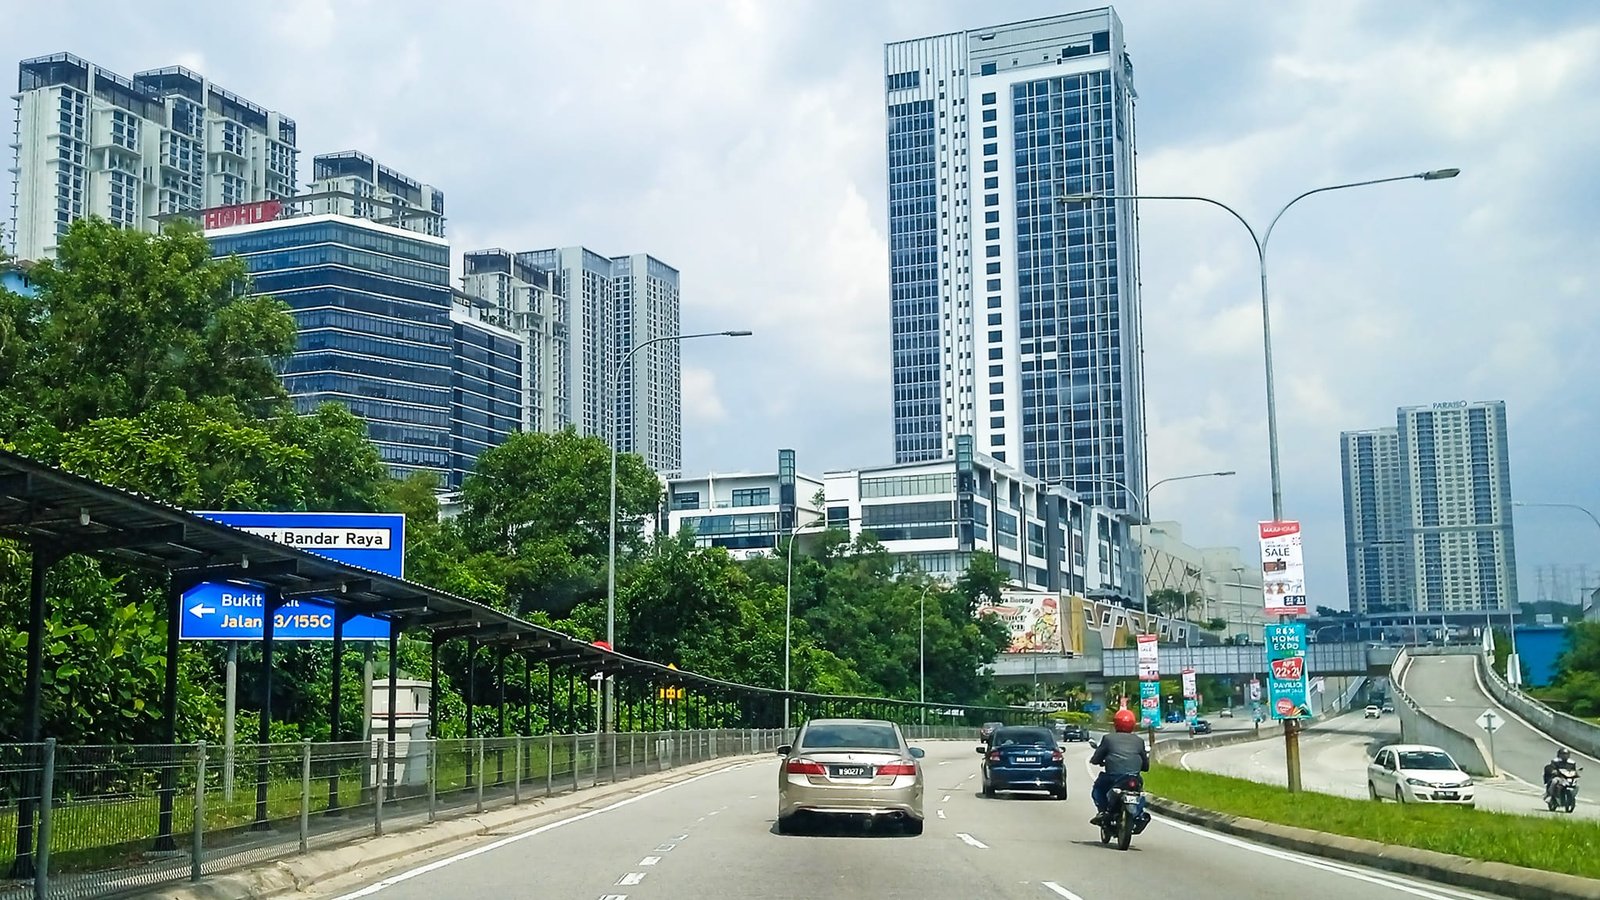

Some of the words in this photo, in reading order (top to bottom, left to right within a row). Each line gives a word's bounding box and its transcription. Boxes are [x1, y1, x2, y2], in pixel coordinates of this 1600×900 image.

[284, 531, 340, 546] Bandar
[345, 532, 383, 547] Raya
[1265, 547, 1290, 557] SALE
[221, 593, 263, 607] Bukit
[220, 614, 263, 628] Jalan
[1275, 627, 1295, 635] REX
[1271, 635, 1300, 643] HOME
